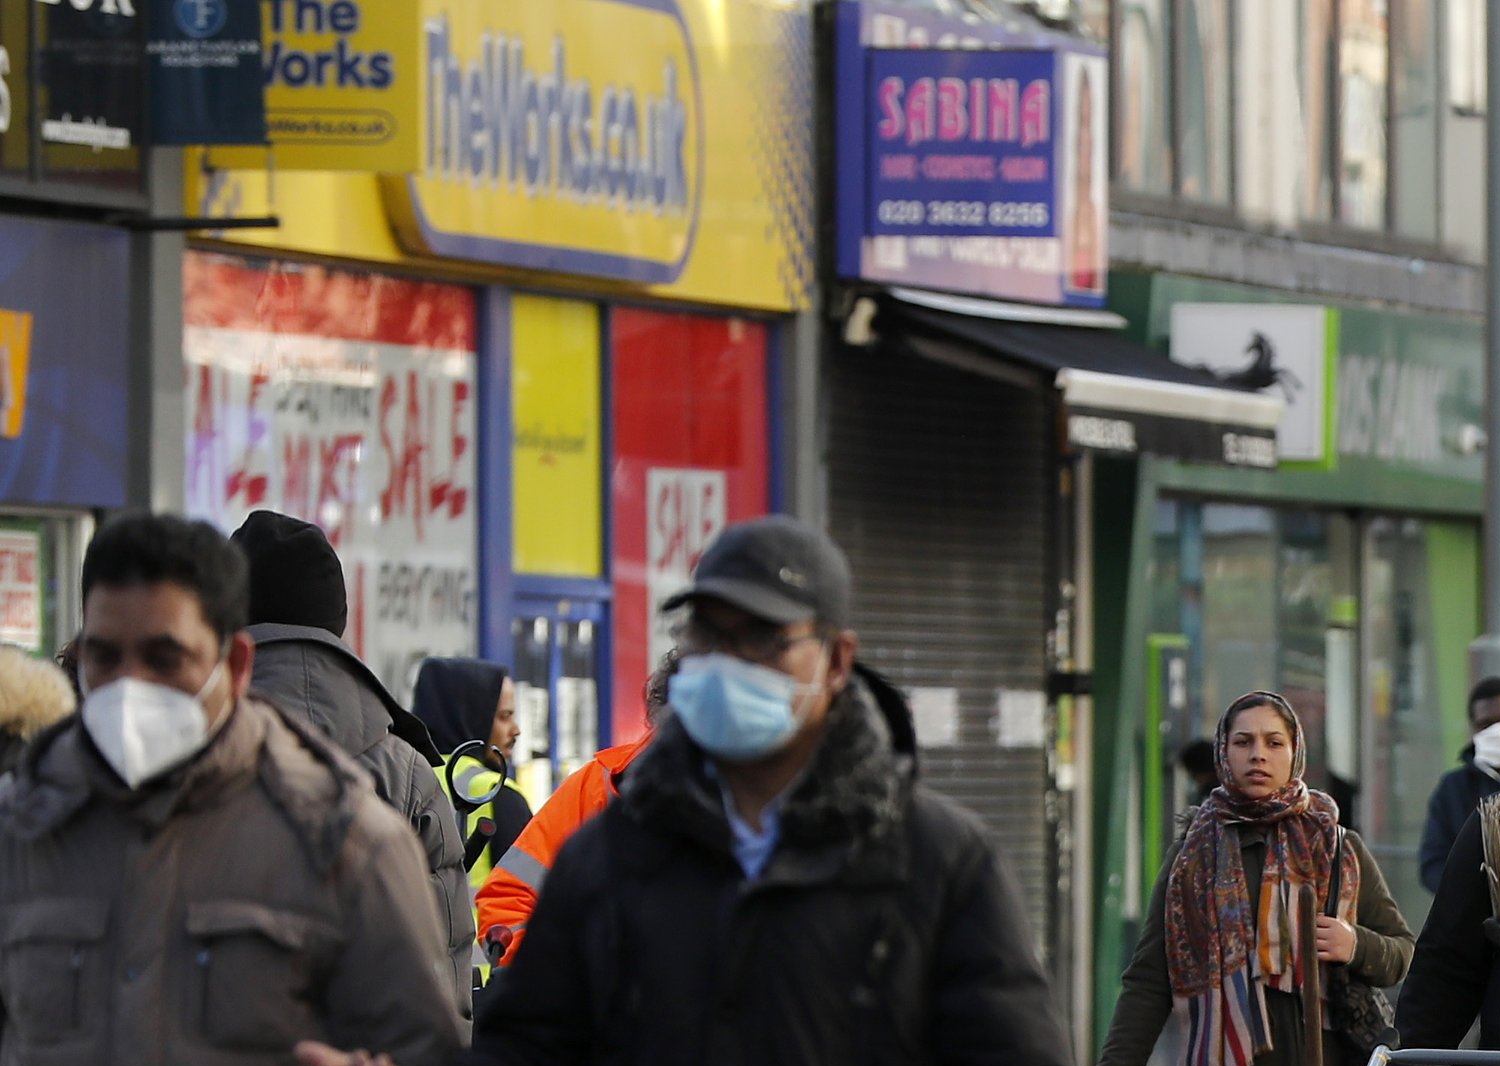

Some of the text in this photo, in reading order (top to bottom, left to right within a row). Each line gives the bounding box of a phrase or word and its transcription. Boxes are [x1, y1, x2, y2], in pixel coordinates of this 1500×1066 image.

[878, 76, 1051, 147] SABINA
[878, 199, 925, 225] 020
[927, 201, 987, 226] 3632
[379, 369, 469, 543] SALE
